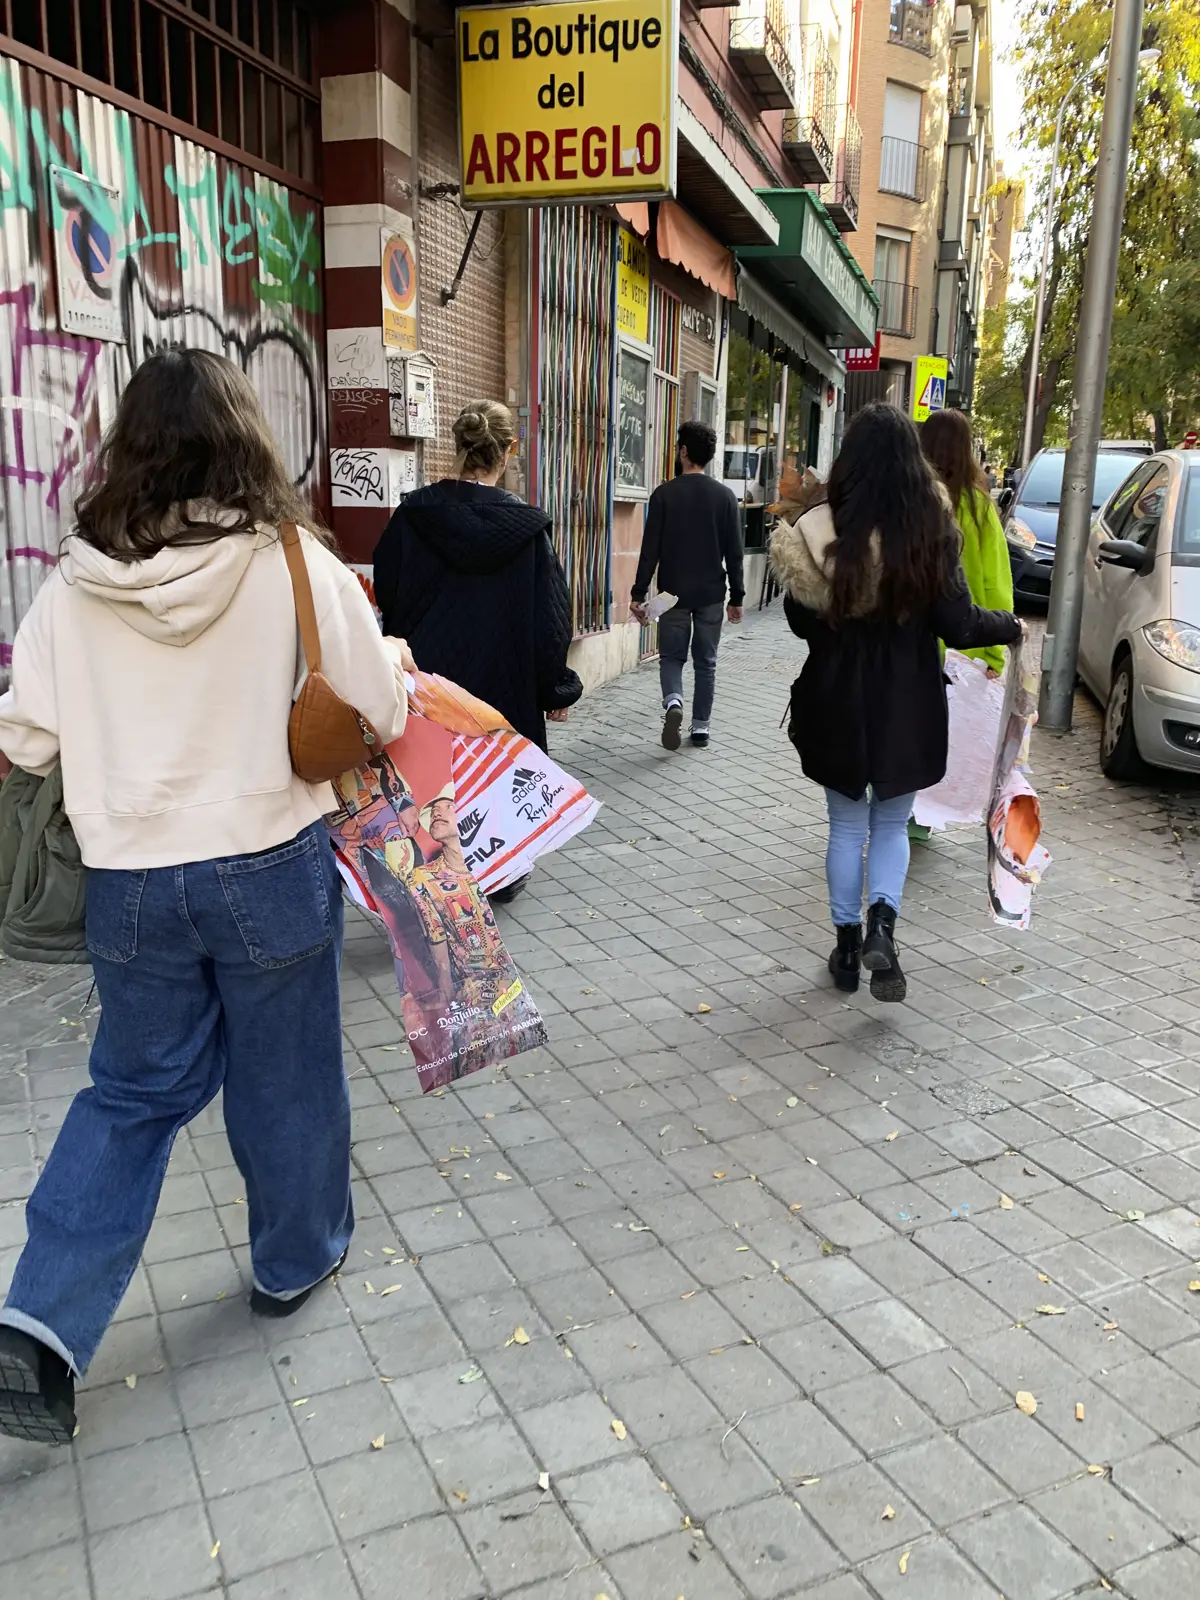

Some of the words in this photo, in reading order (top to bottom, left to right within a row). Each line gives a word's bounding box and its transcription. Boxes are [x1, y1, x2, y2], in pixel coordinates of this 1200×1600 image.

[462, 21, 500, 62] La
[511, 13, 662, 63] Boutique
[537, 71, 585, 109] del
[465, 122, 662, 186] ARREGLO
[806, 213, 823, 267] BAR
[512, 770, 547, 804] adidas
[457, 808, 481, 837] NIKE
[464, 837, 506, 872] FILA
[416, 1056, 448, 1073] Estación
[448, 1051, 458, 1060] de
